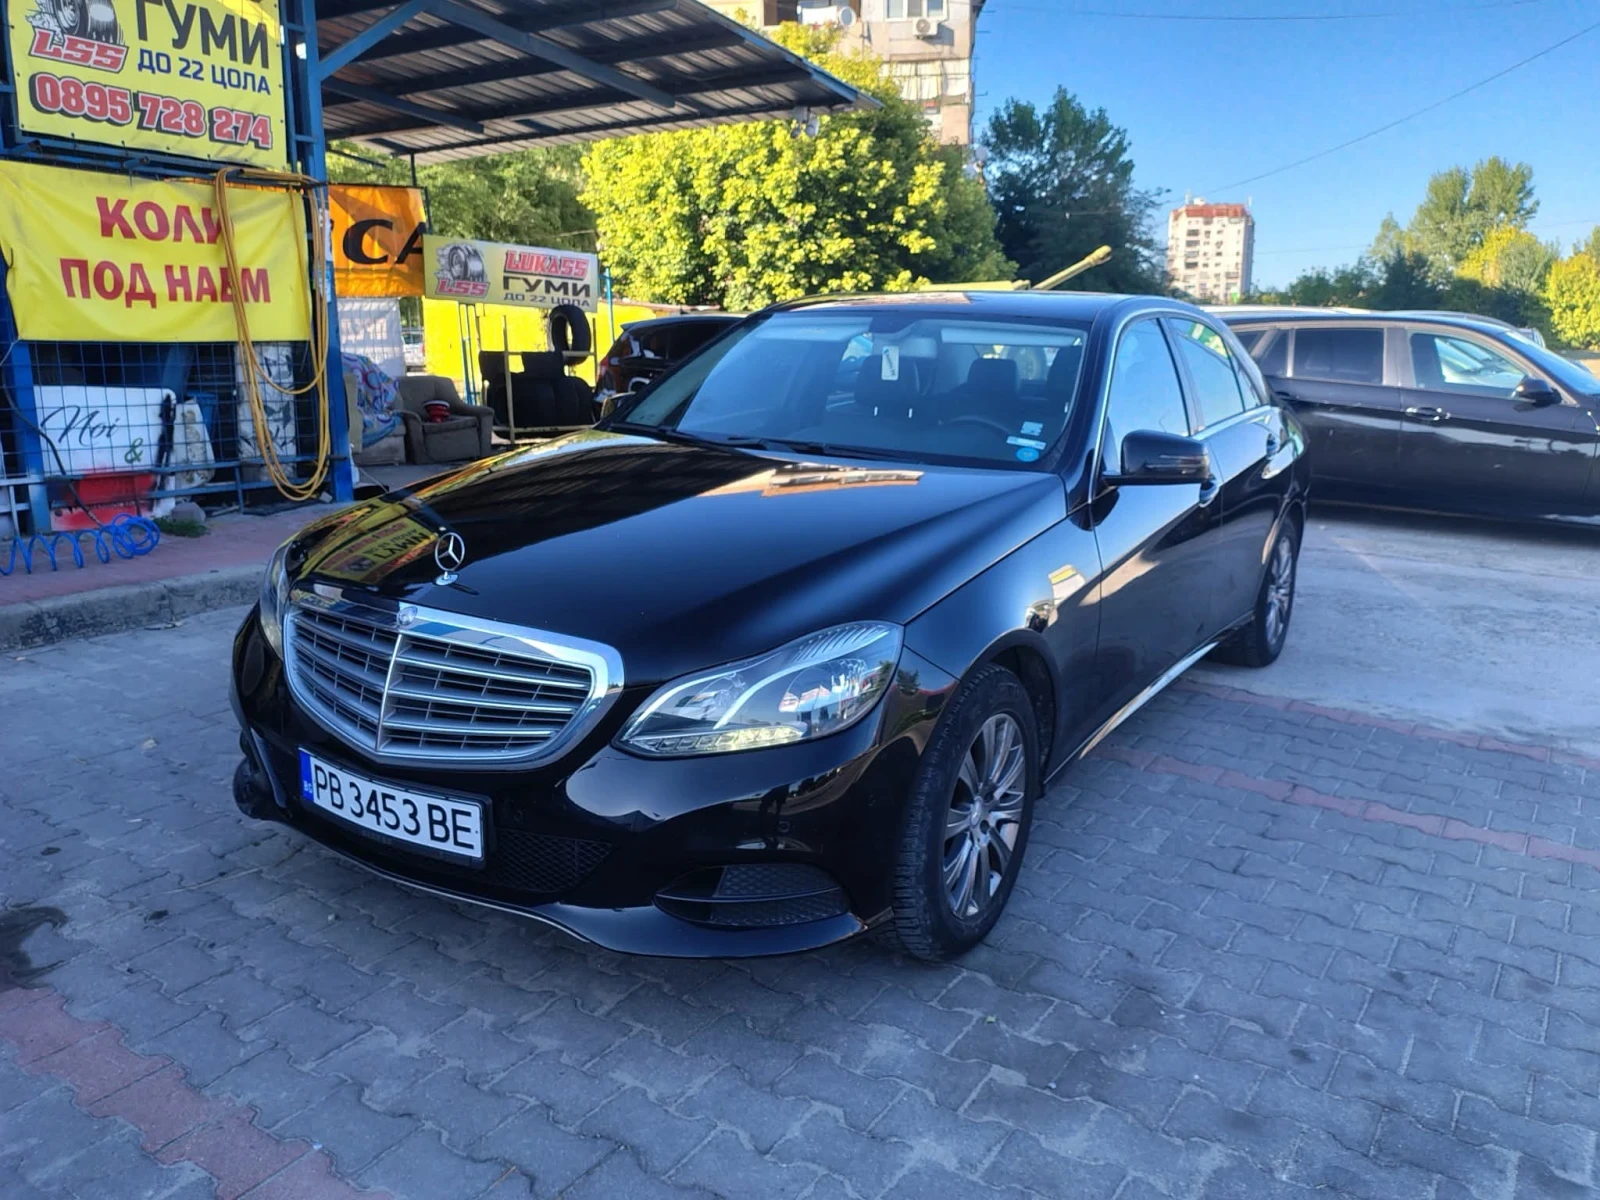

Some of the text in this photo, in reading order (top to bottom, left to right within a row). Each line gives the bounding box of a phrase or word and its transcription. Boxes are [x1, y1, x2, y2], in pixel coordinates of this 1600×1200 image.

[135, 0, 269, 69] ГУМИ
[138, 48, 271, 95] ДО 22 ЦОЛА
[30, 72, 272, 150] 0895 728 274
[59, 258, 157, 309] ПОД
[504, 250, 589, 281] LUKASS
[503, 276, 590, 298] ГУМИ
[504, 292, 526, 302] ДО
[529, 294, 547, 303] 22
[124, 437, 144, 464] &
